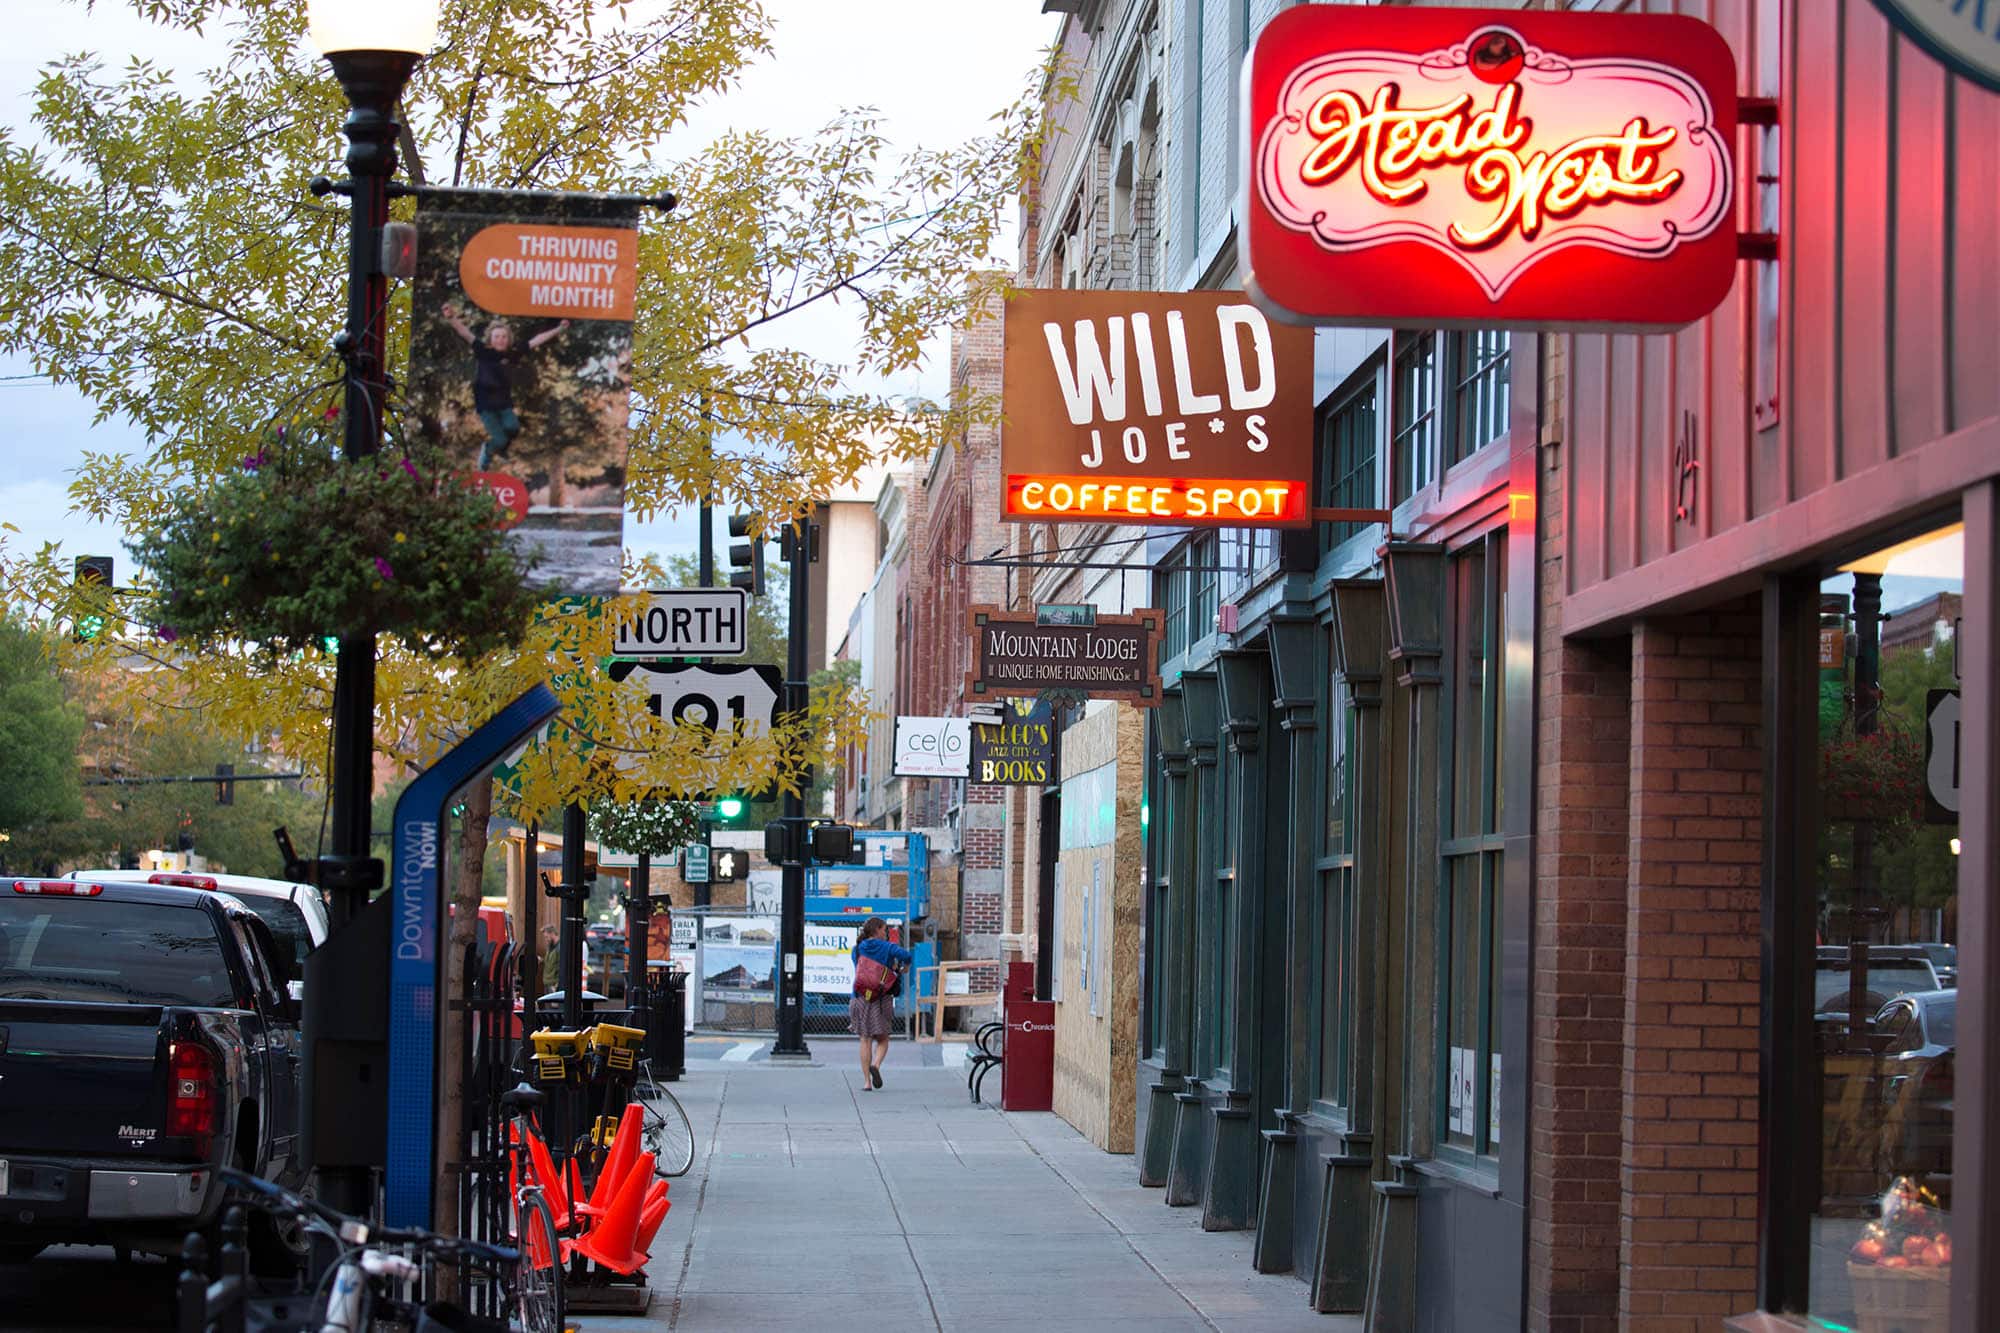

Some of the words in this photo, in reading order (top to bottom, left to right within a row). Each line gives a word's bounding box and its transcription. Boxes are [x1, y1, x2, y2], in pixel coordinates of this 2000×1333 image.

[1299, 81, 1532, 206] Head
[1447, 116, 1685, 252] West
[518, 235, 618, 260] THRIVING
[486, 258, 617, 284] COMMUNITY
[531, 284, 615, 309] MONTH!
[1043, 304, 1277, 425] WILD
[1021, 482, 1172, 516] COFFEE
[1185, 487, 1290, 516] SPOT
[620, 607, 737, 644] NORTH
[998, 664, 1034, 681] UNIQUE
[1035, 665, 1063, 680] HOME
[1065, 666, 1124, 682] FURNISHINGS
[908, 721, 962, 766] cello
[978, 724, 1050, 746] VARGO'S
[987, 746, 1009, 758] JAZZ
[1011, 746, 1032, 758] CITY
[981, 760, 1047, 783] BOOKS
[420, 821, 437, 869] NOW!
[397, 820, 424, 960] Downtown
[812, 974, 851, 985] 388-5575
